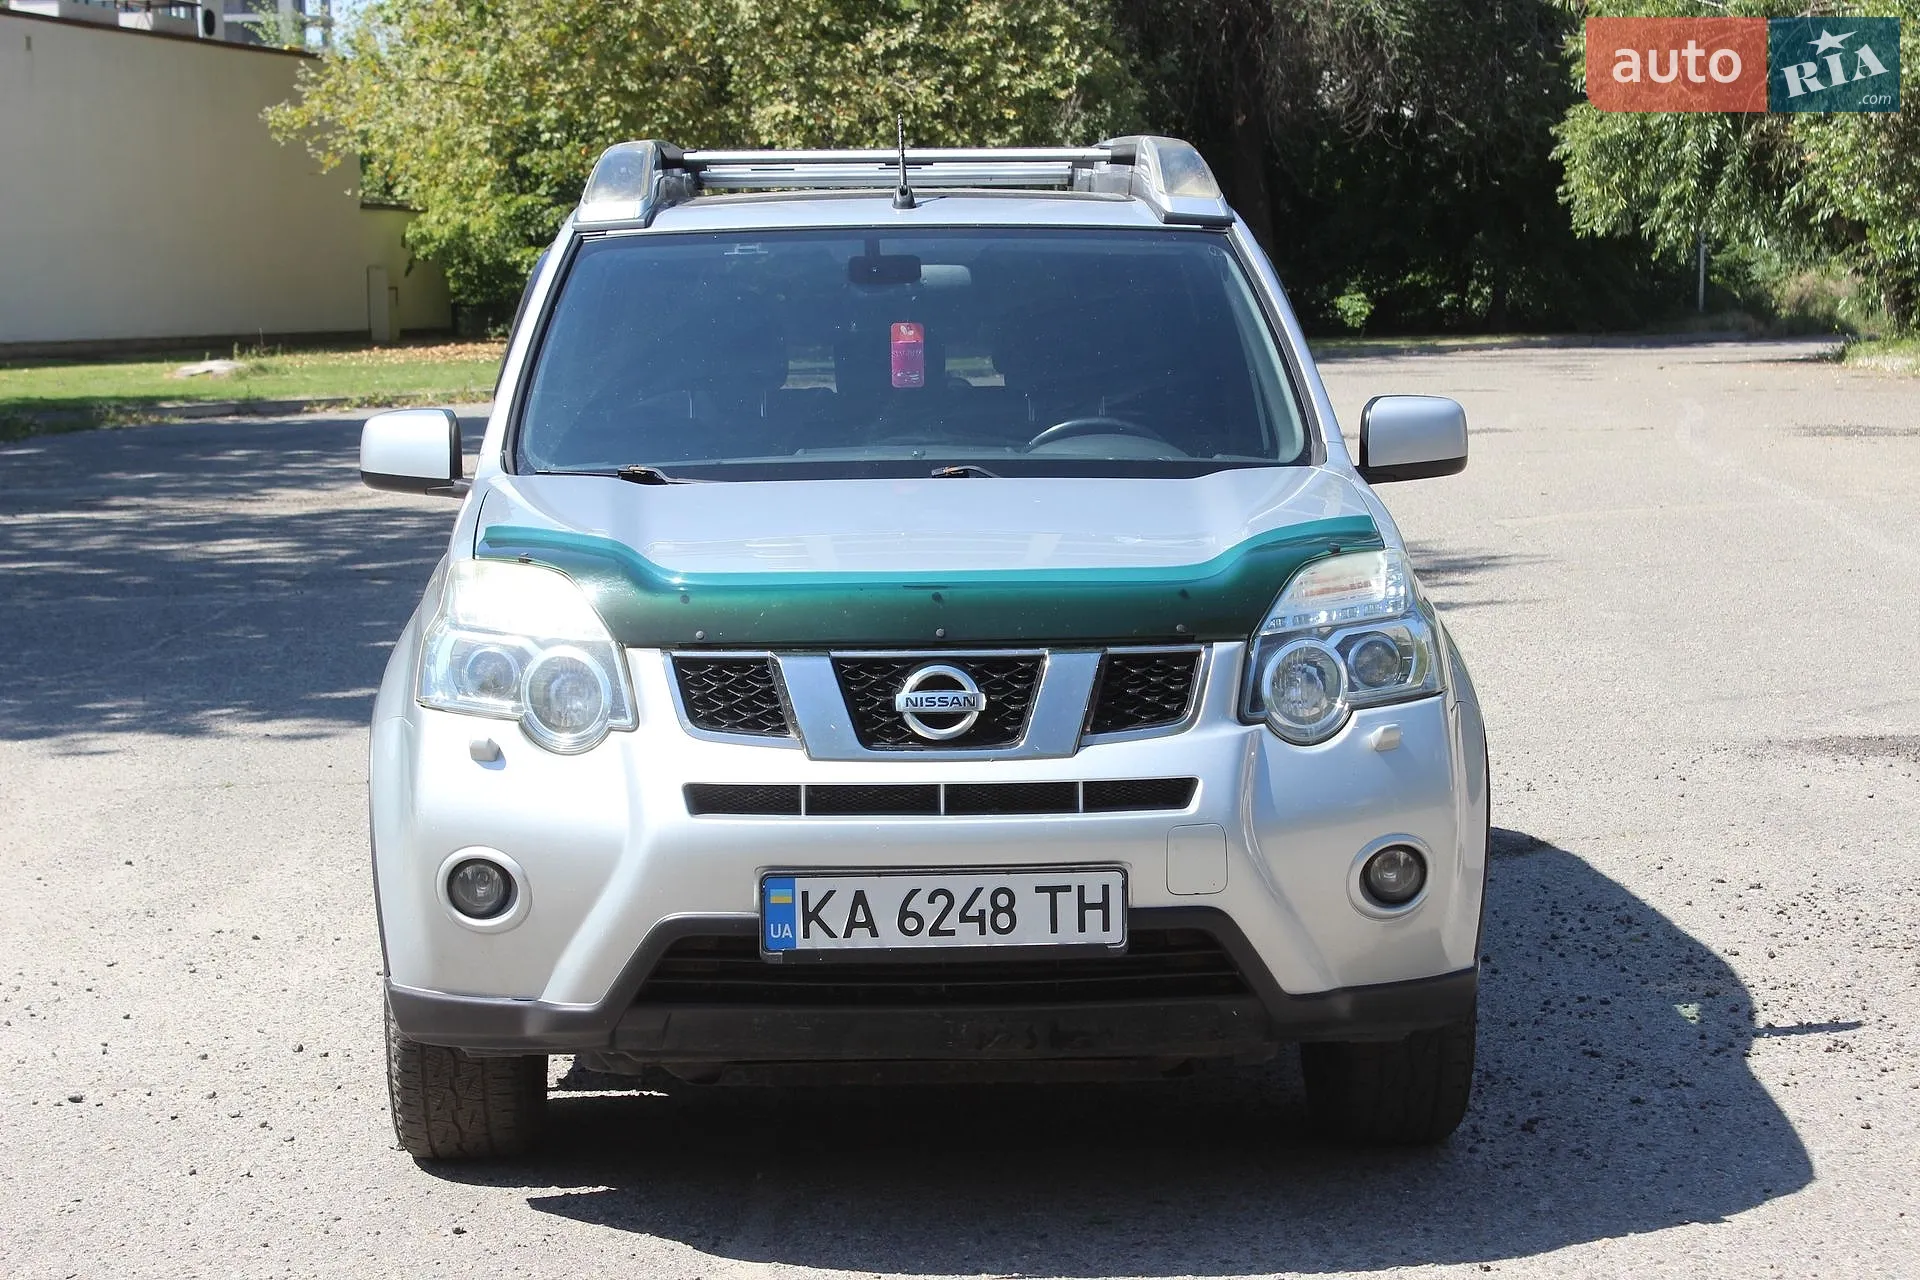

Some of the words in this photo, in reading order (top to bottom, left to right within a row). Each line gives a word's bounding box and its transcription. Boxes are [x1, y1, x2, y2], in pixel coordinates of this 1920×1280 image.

[905, 696, 976, 707] NISSAN
[801, 889, 879, 939] KA
[897, 887, 1017, 937] 6248
[1035, 884, 1110, 933] TH
[770, 924, 793, 938] UA
